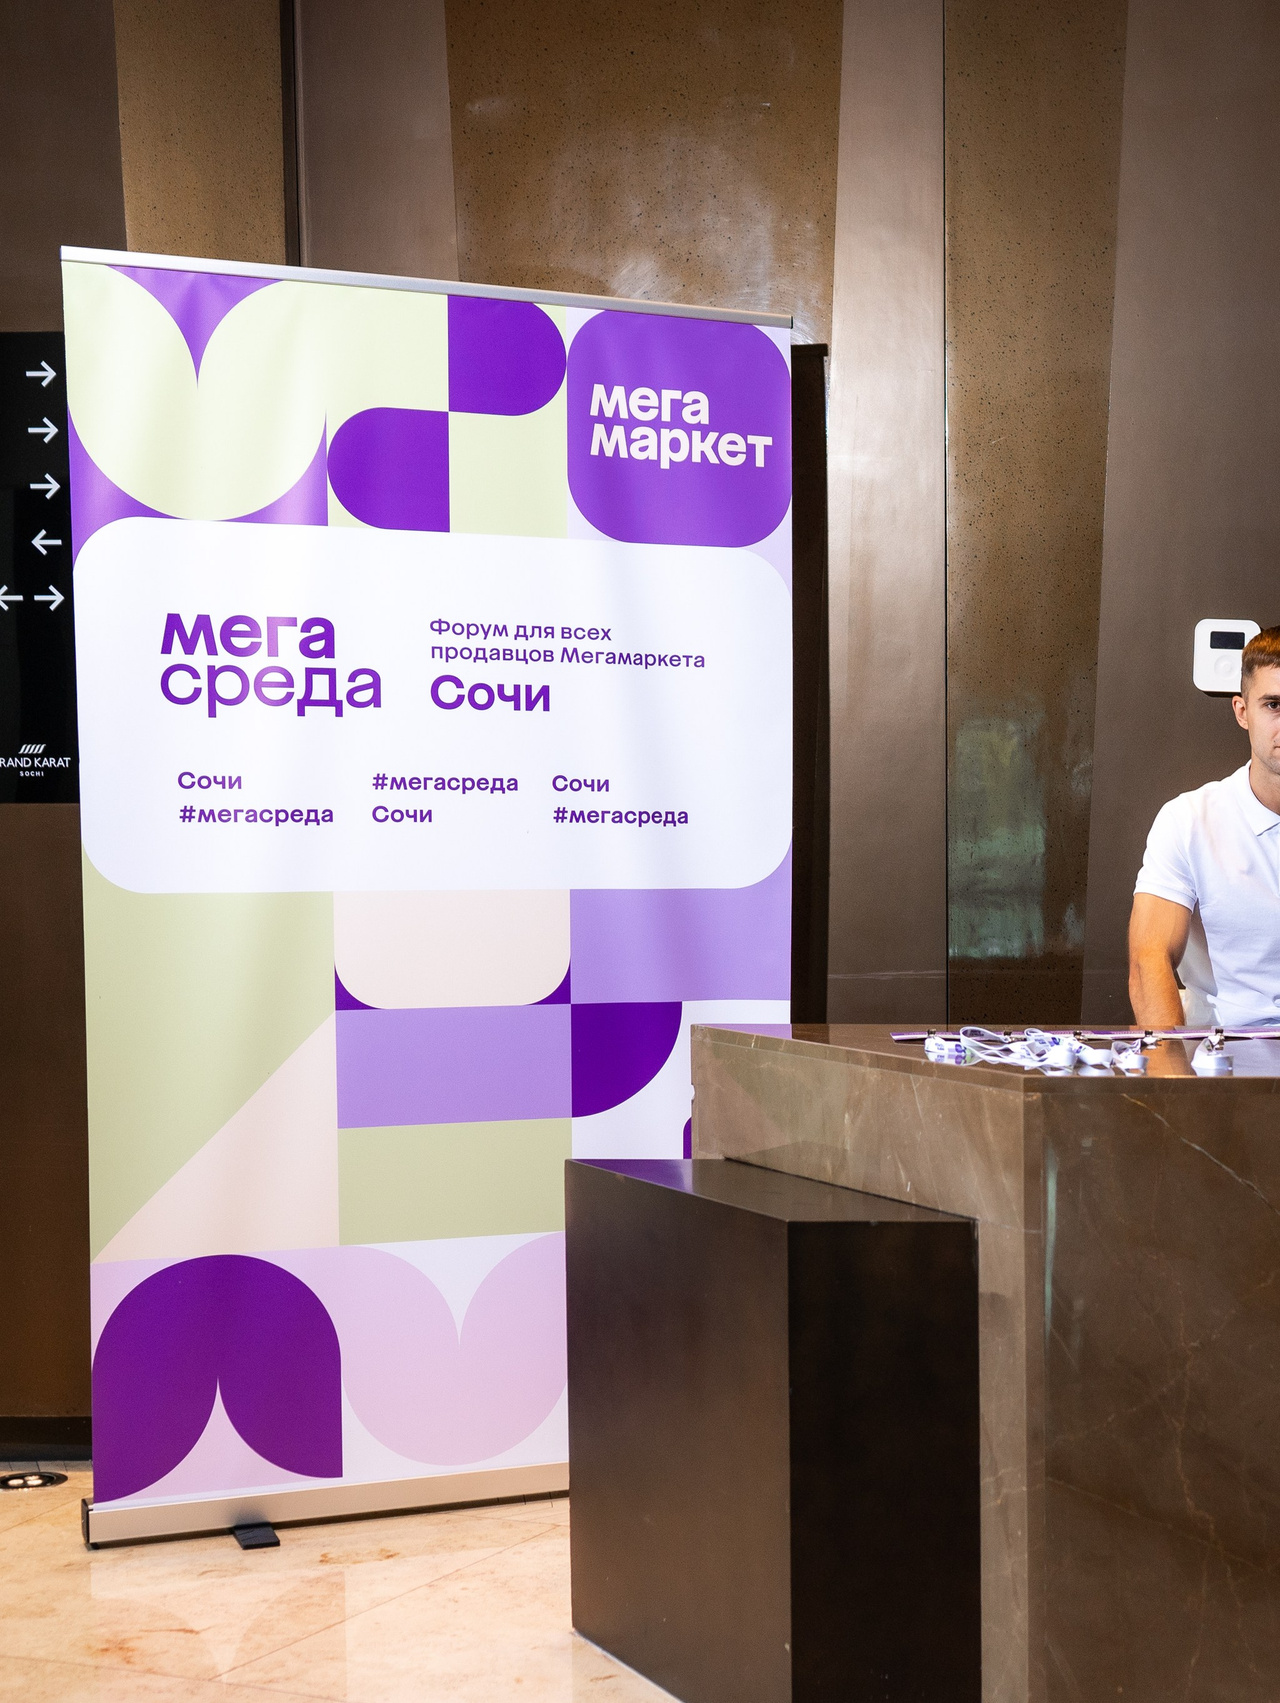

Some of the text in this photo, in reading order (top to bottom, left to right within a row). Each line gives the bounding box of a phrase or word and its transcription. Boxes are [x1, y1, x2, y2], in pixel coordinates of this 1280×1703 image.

[589, 384, 710, 424] мега
[590, 423, 773, 470] маркет
[160, 612, 336, 660] мега
[429, 619, 612, 641] Форум для всех
[431, 645, 705, 670] продавцов Мегамаркета
[160, 663, 382, 719] среда
[430, 675, 551, 712] Сочи
[34, 757, 71, 768] KARAT
[177, 771, 242, 790] Сочи
[372, 773, 519, 795] #мегасреда
[551, 774, 610, 793] Сочи
[179, 805, 334, 827] #мегасреда
[371, 805, 433, 823] Сочи
[552, 806, 689, 828] #мегасреда
